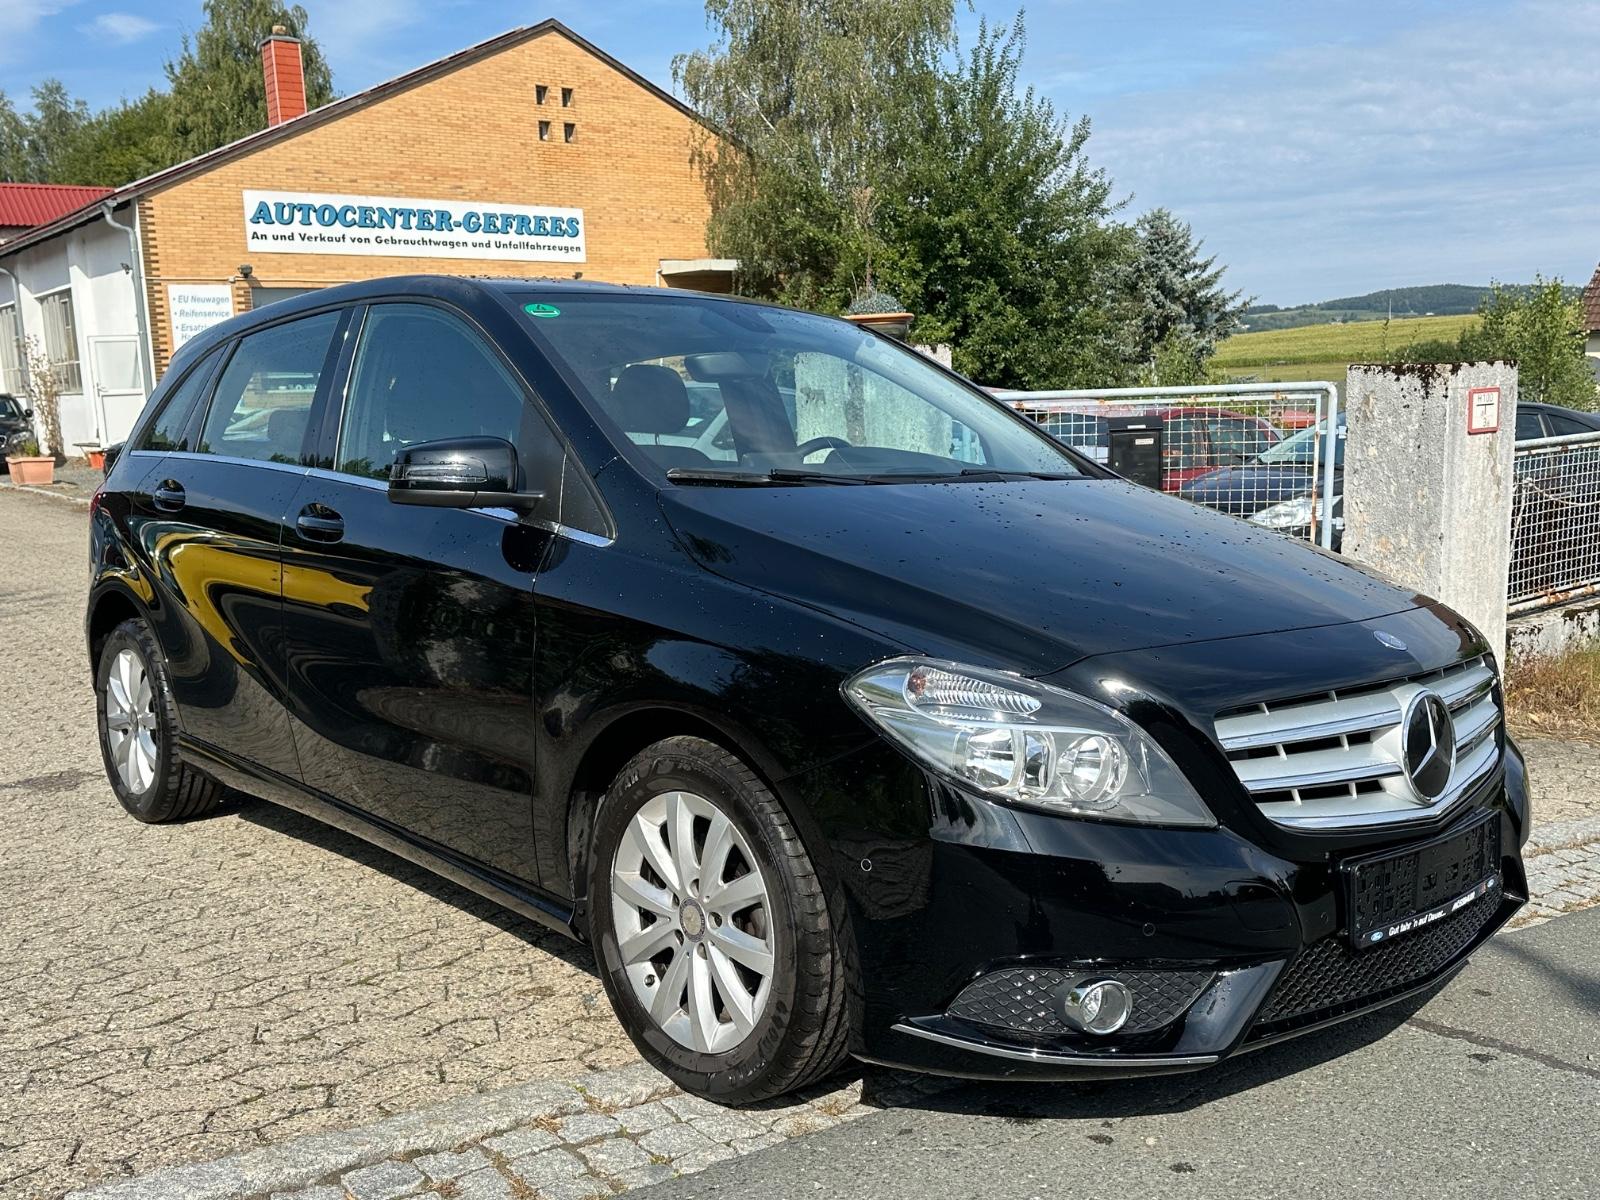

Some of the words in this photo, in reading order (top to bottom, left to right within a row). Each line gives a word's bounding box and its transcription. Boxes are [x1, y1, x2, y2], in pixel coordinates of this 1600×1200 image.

[250, 201, 580, 238] AUTOCENTER-GEFREES
[251, 231, 268, 241] An
[272, 232, 295, 242] und
[298, 233, 346, 244] Verkauf
[349, 236, 371, 245] von
[375, 236, 469, 249] Gebrauchtwagen
[471, 239, 492, 249] und
[495, 241, 582, 253] Unfallfahrzeugen
[178, 295, 189, 303] EU
[191, 296, 229, 305] Neuwagen
[179, 309, 230, 318] Reifenservice
